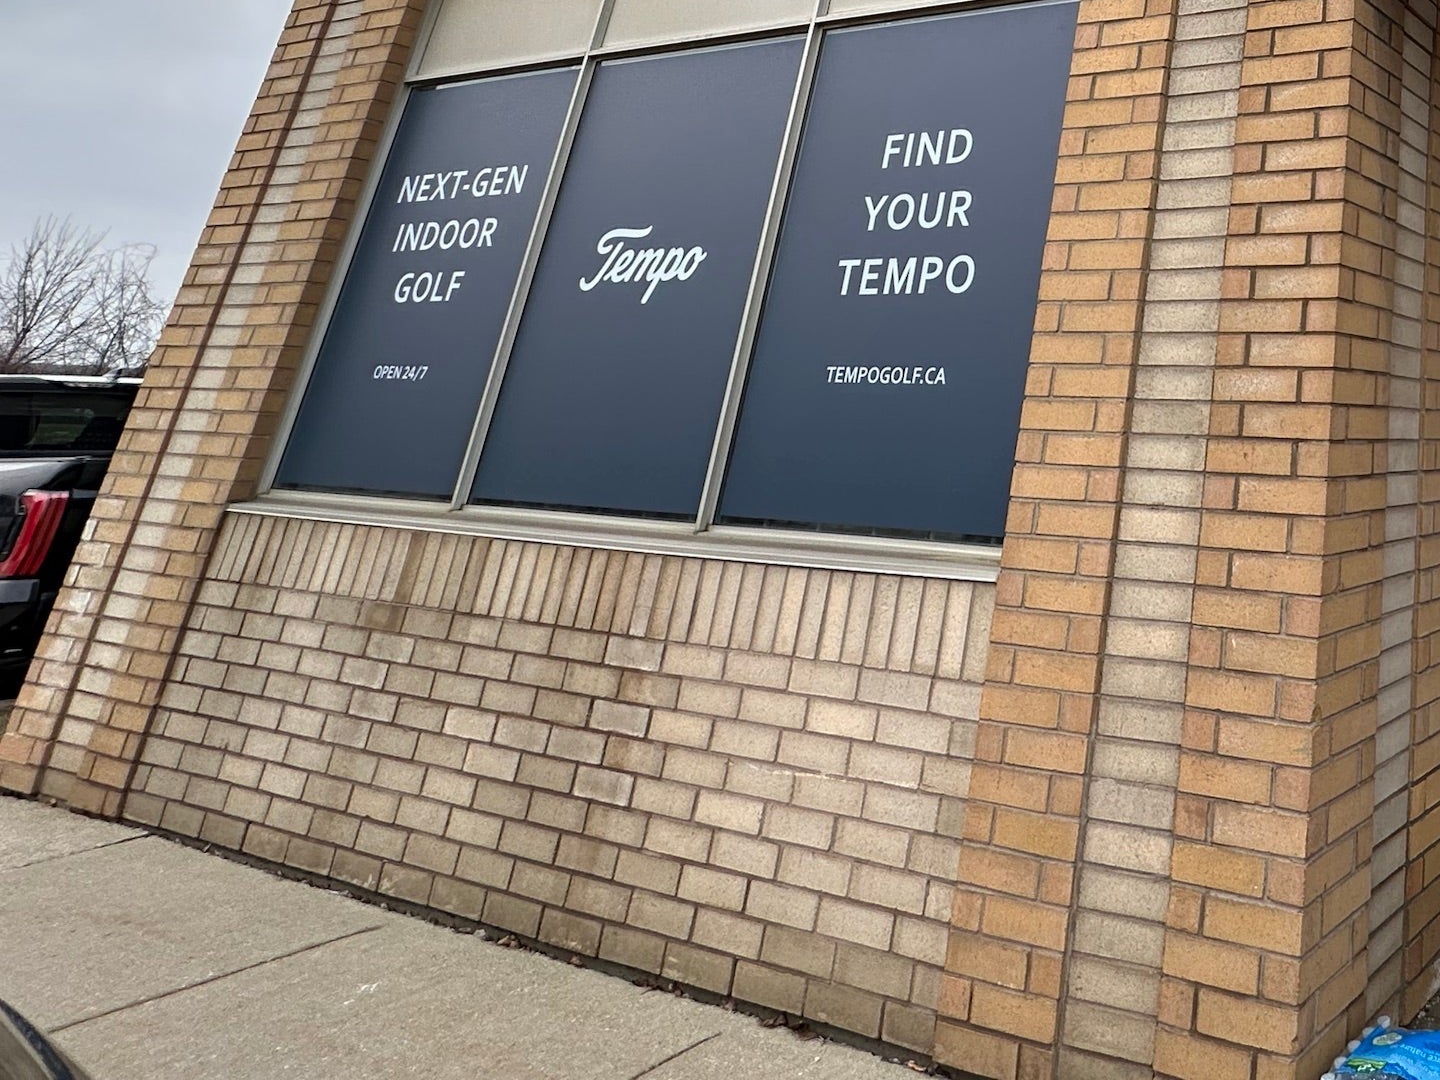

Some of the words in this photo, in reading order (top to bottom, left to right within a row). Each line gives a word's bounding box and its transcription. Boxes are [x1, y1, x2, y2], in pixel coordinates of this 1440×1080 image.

[881, 128, 973, 169] FIND
[396, 164, 529, 204] NEXT-GEN
[864, 190, 973, 232] YOUR
[392, 217, 498, 253] INDOOR
[579, 224, 708, 305] Tempo
[838, 254, 976, 297] TEMPO
[394, 270, 466, 304] GOLF
[373, 365, 403, 380] OPEN
[401, 365, 429, 382] 24/7
[826, 366, 946, 385] TEMPOGOLF.CA
